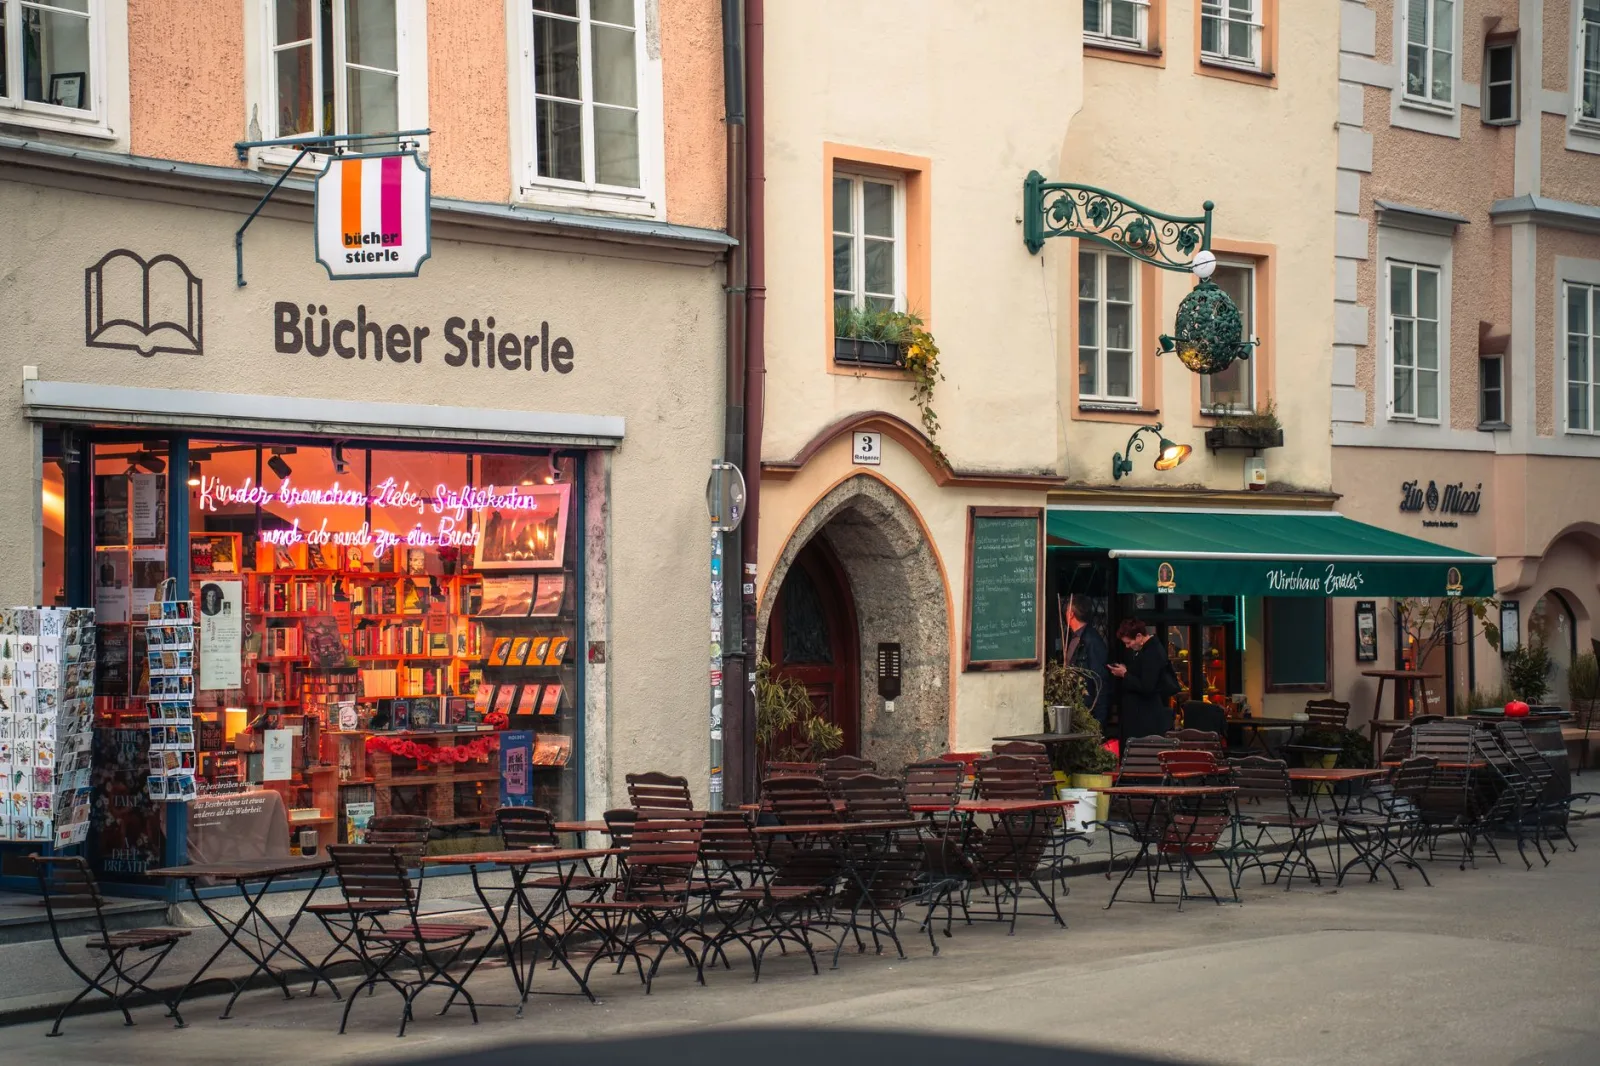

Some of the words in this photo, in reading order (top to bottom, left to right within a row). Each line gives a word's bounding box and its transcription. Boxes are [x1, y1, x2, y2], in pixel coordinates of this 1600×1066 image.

[344, 232, 399, 245] bücher
[346, 249, 399, 263] stierle
[275, 302, 430, 363] Bücher
[444, 316, 574, 374] Stierle
[862, 435, 873, 452] 3
[200, 475, 273, 511] Kinder
[279, 477, 368, 506] brauchen
[374, 476, 424, 514] Liebe,
[432, 483, 537, 521] Süßigkeiten
[262, 518, 302, 545] und
[308, 517, 330, 544] ab
[334, 521, 372, 545] und
[373, 528, 400, 558] zu
[407, 522, 435, 546] ein
[438, 516, 480, 547] Buch
[1266, 567, 1320, 590] Wirtshaus
